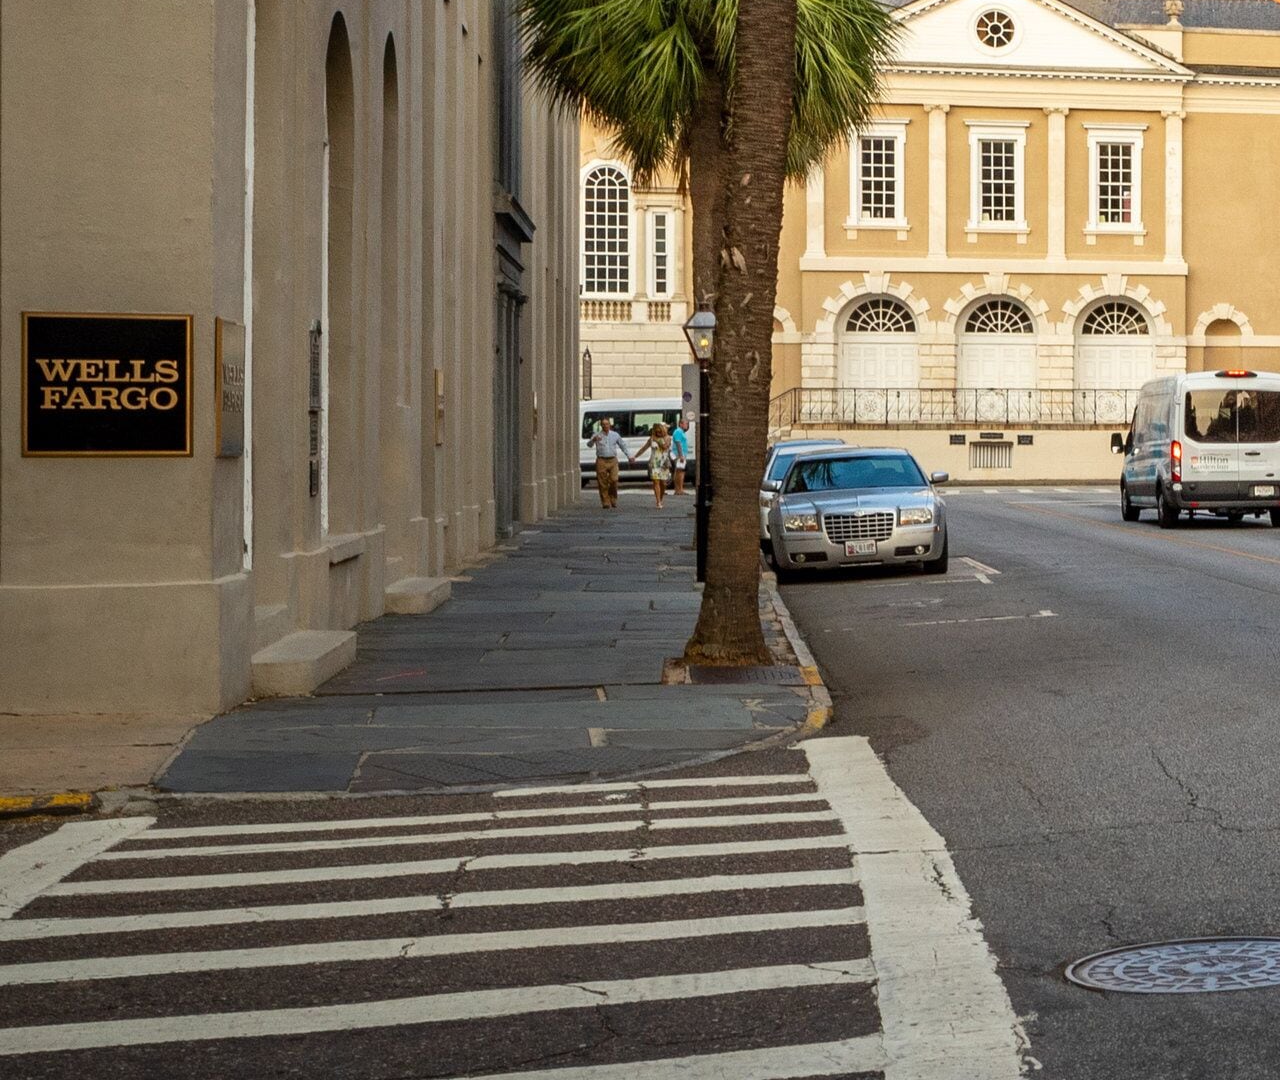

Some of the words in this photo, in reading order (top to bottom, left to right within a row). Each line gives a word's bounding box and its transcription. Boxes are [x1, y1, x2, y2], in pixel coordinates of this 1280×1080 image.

[35, 359, 179, 383] WELLS
[40, 386, 179, 410] FARGO
[1200, 456, 1228, 464] Hilton
